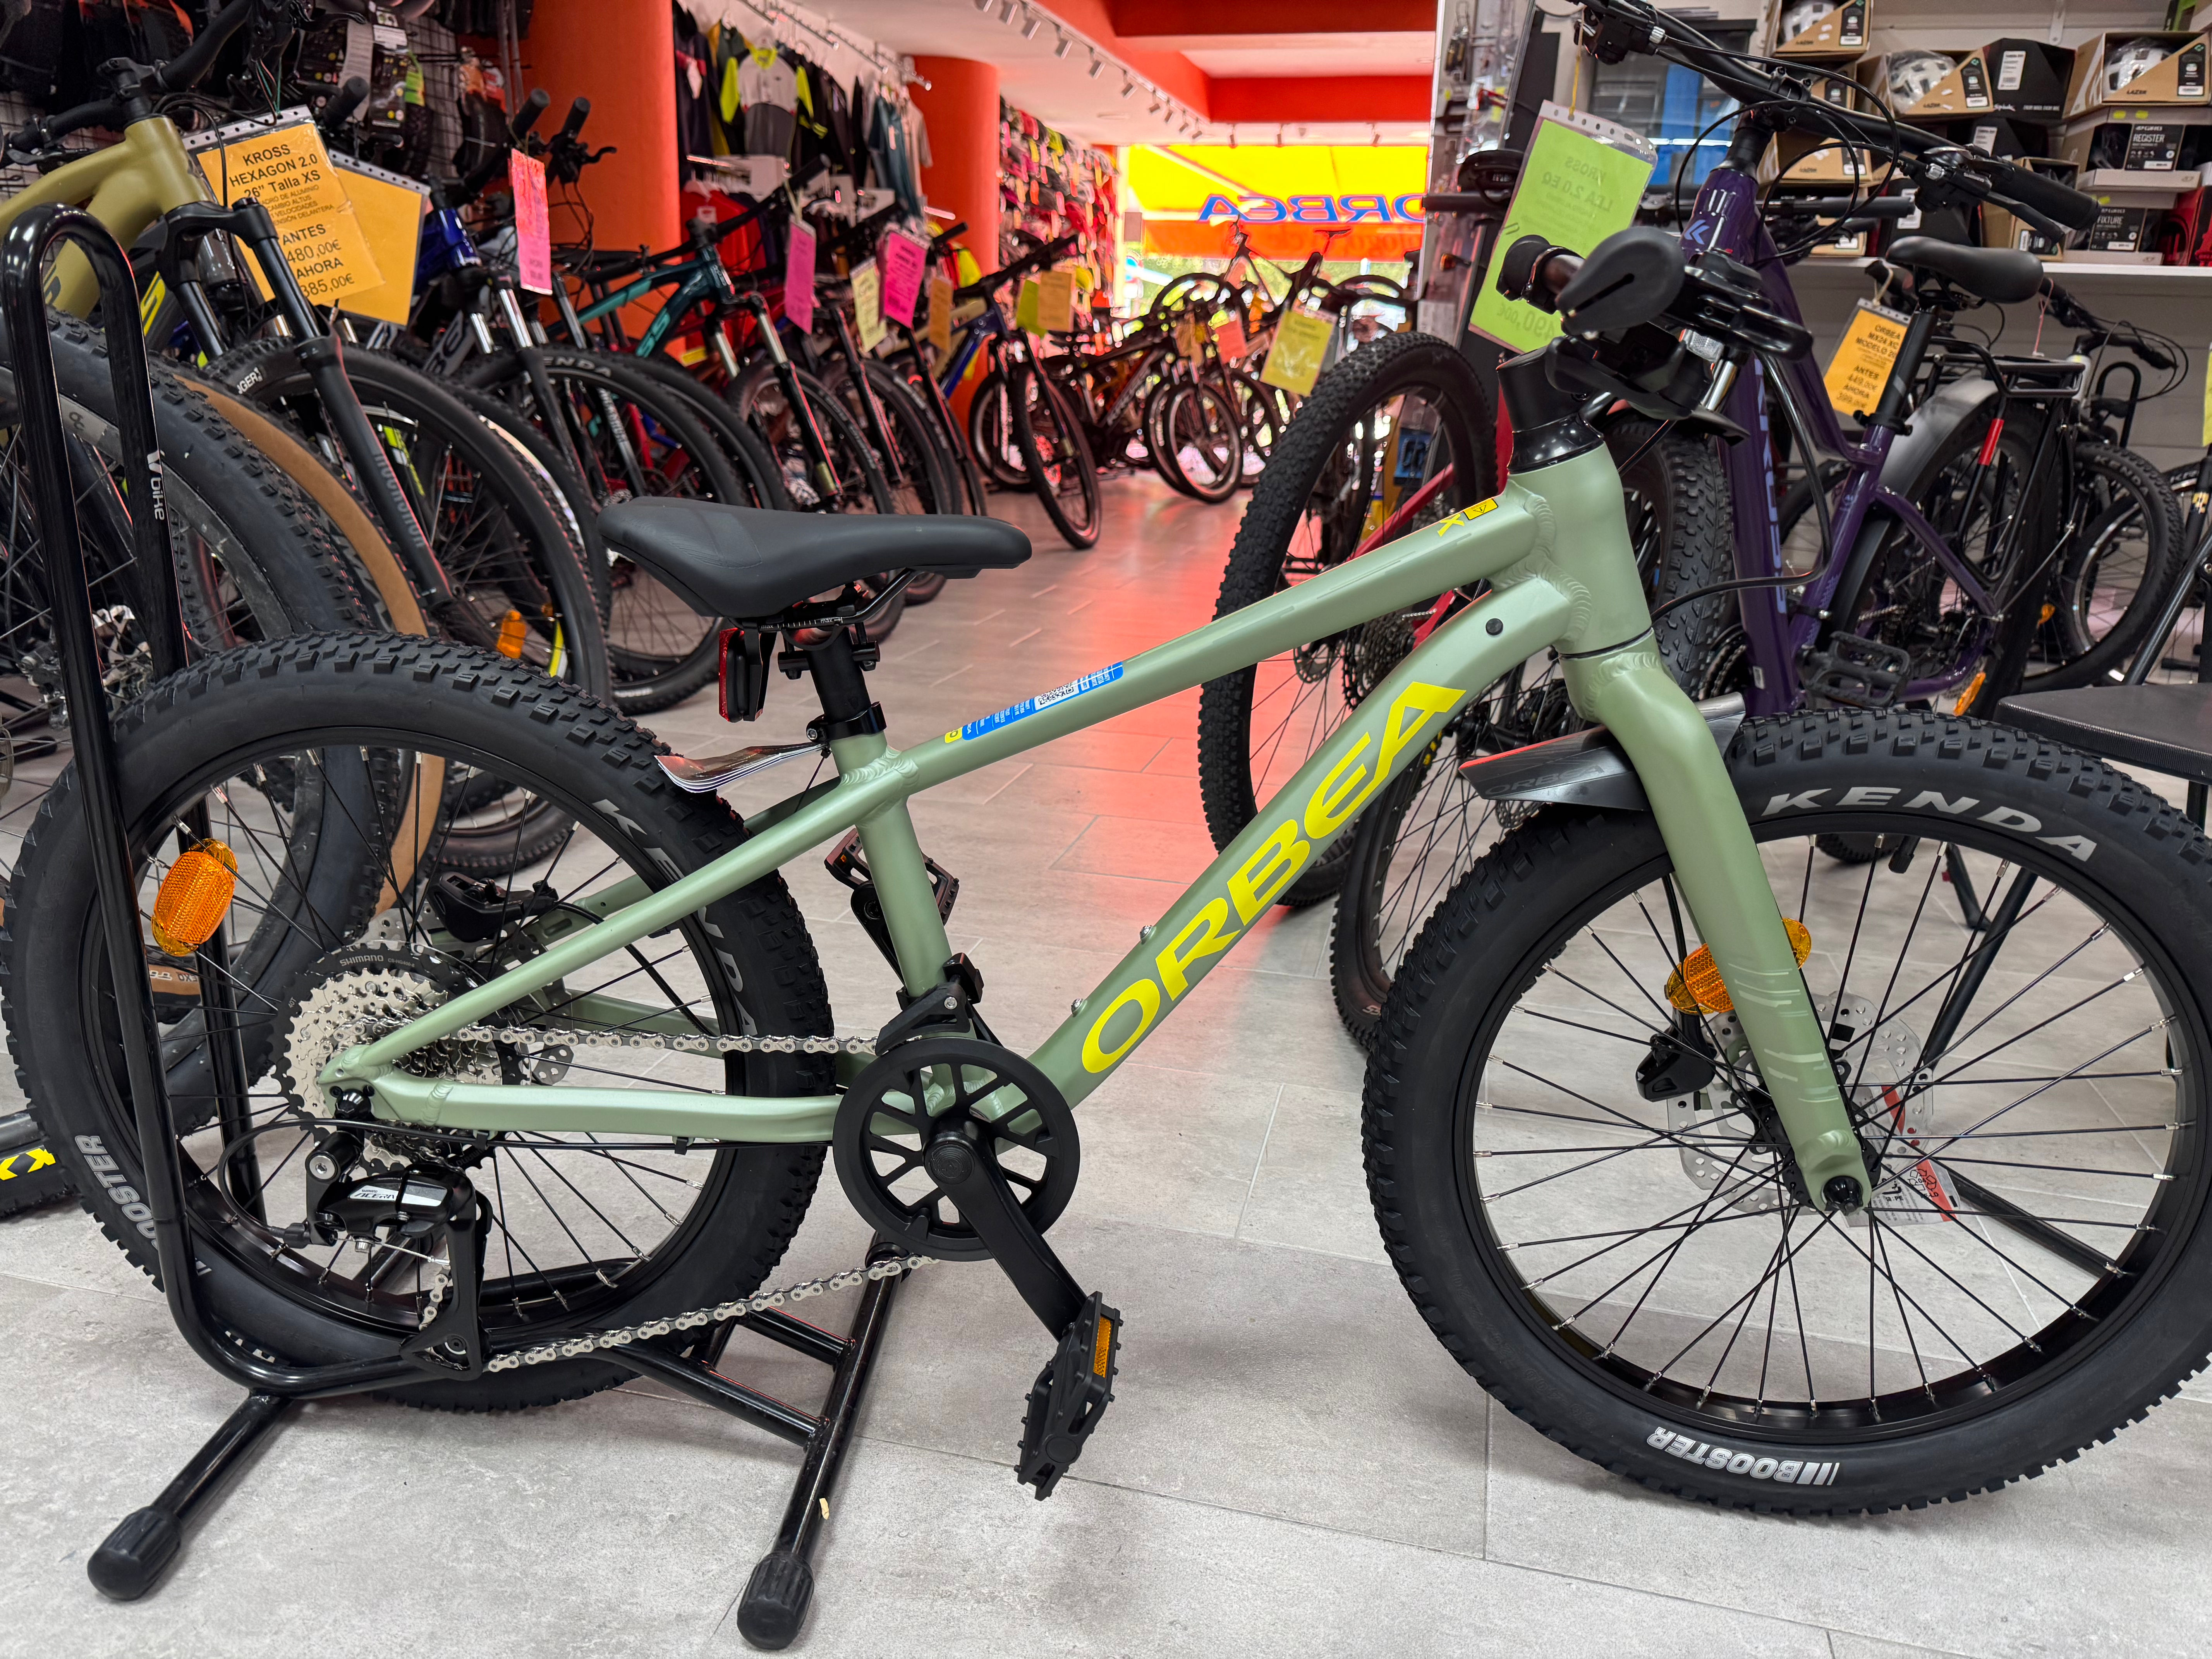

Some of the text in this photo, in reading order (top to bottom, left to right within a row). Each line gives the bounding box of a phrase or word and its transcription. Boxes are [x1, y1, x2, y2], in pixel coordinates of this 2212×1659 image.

[2133, 134, 2165, 143] REGISTER
[242, 144, 291, 166] KROSS
[229, 153, 318, 187] HEXAGON 2.0
[268, 176, 301, 194] Talla
[304, 170, 321, 184] XS
[261, 184, 320, 205] ADRO DE ALUMINIO
[292, 195, 312, 206] ALTUS
[273, 204, 335, 227] ENSIÓN DELANTERA
[275, 201, 318, 217] VELOCIDADES
[282, 224, 326, 246] ANTES
[287, 239, 342, 264] 480,00€
[296, 257, 344, 280] AHORA
[542, 356, 611, 378] ENDA
[1853, 365, 1879, 380] ANTES
[1485, 764, 1605, 796] ORBEA
[1761, 787, 2097, 862] KENDA
[1082, 681, 1466, 1073] ORBEA
[340, 955, 384, 966] SHIMANO
[287, 997, 297, 1008] 40T
[75, 1135, 160, 1252] OOSTER
[1646, 1426, 1804, 1483] BOOSTER
